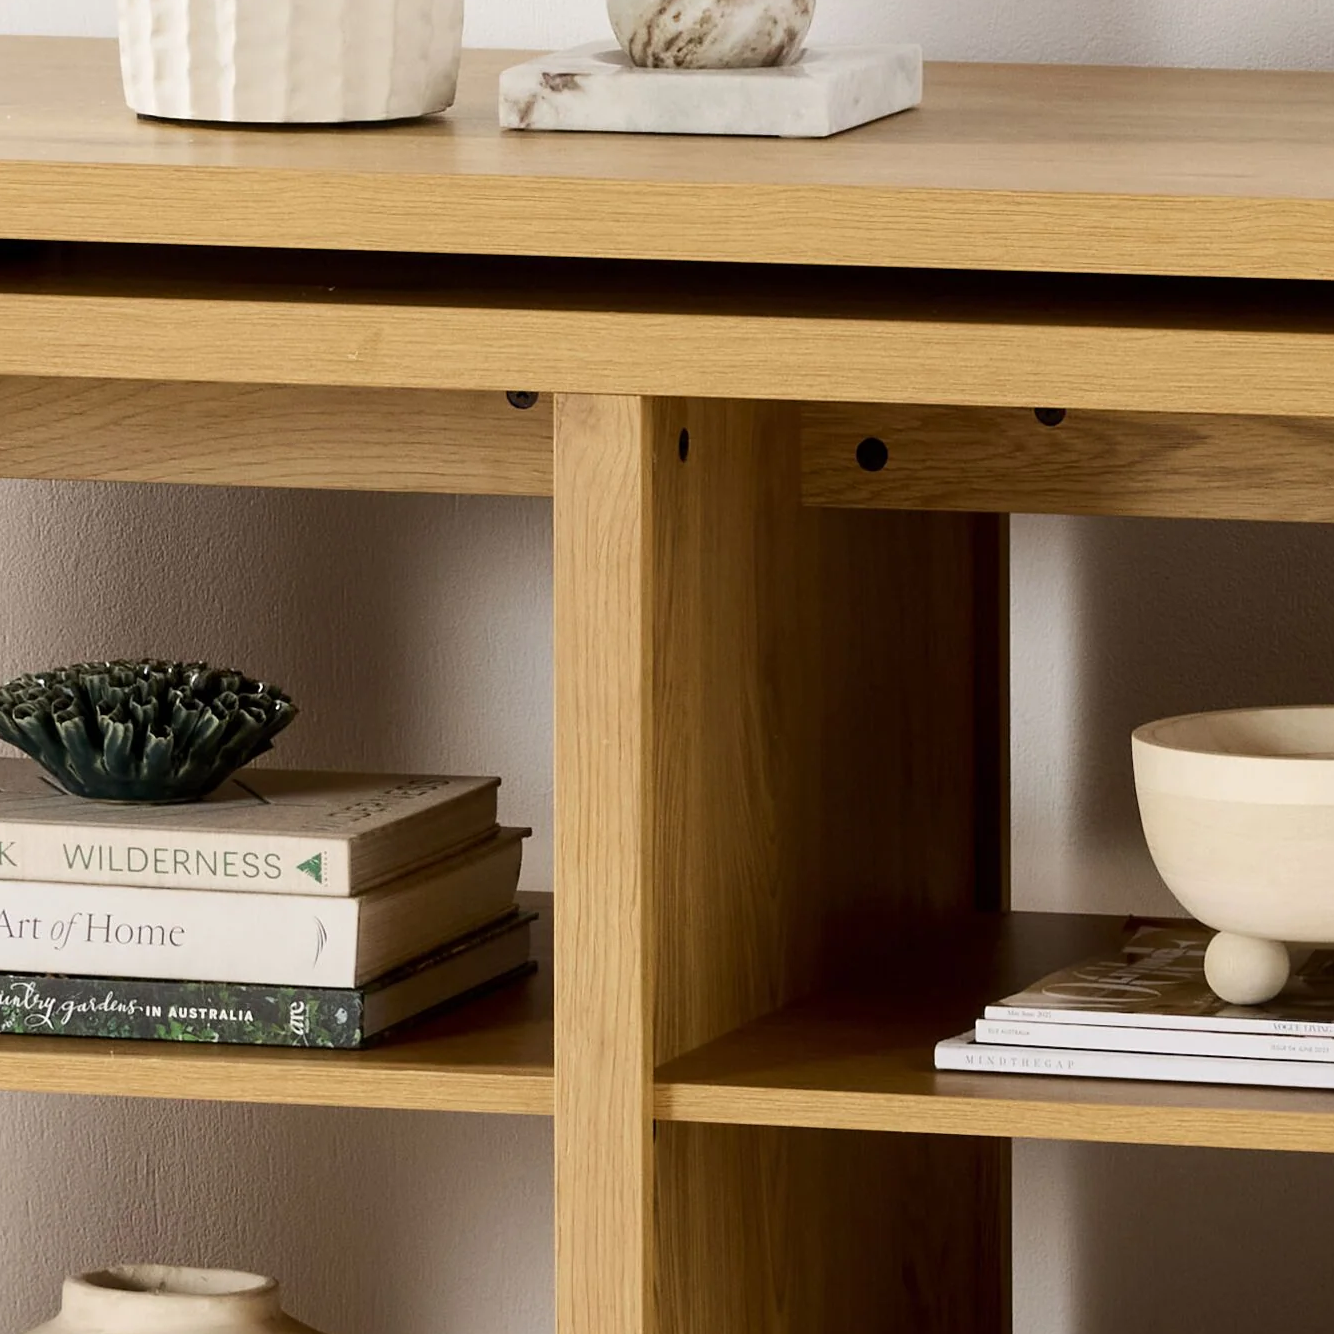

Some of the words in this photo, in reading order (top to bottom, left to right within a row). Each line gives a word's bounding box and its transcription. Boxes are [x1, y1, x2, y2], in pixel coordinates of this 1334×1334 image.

[62, 843, 282, 879] WILDERNESS
[50, 912, 83, 951] of
[84, 913, 186, 947] Home
[57, 990, 144, 1025] gardens
[145, 1005, 162, 1018] IN
[168, 1005, 255, 1022] AUSTRALIA
